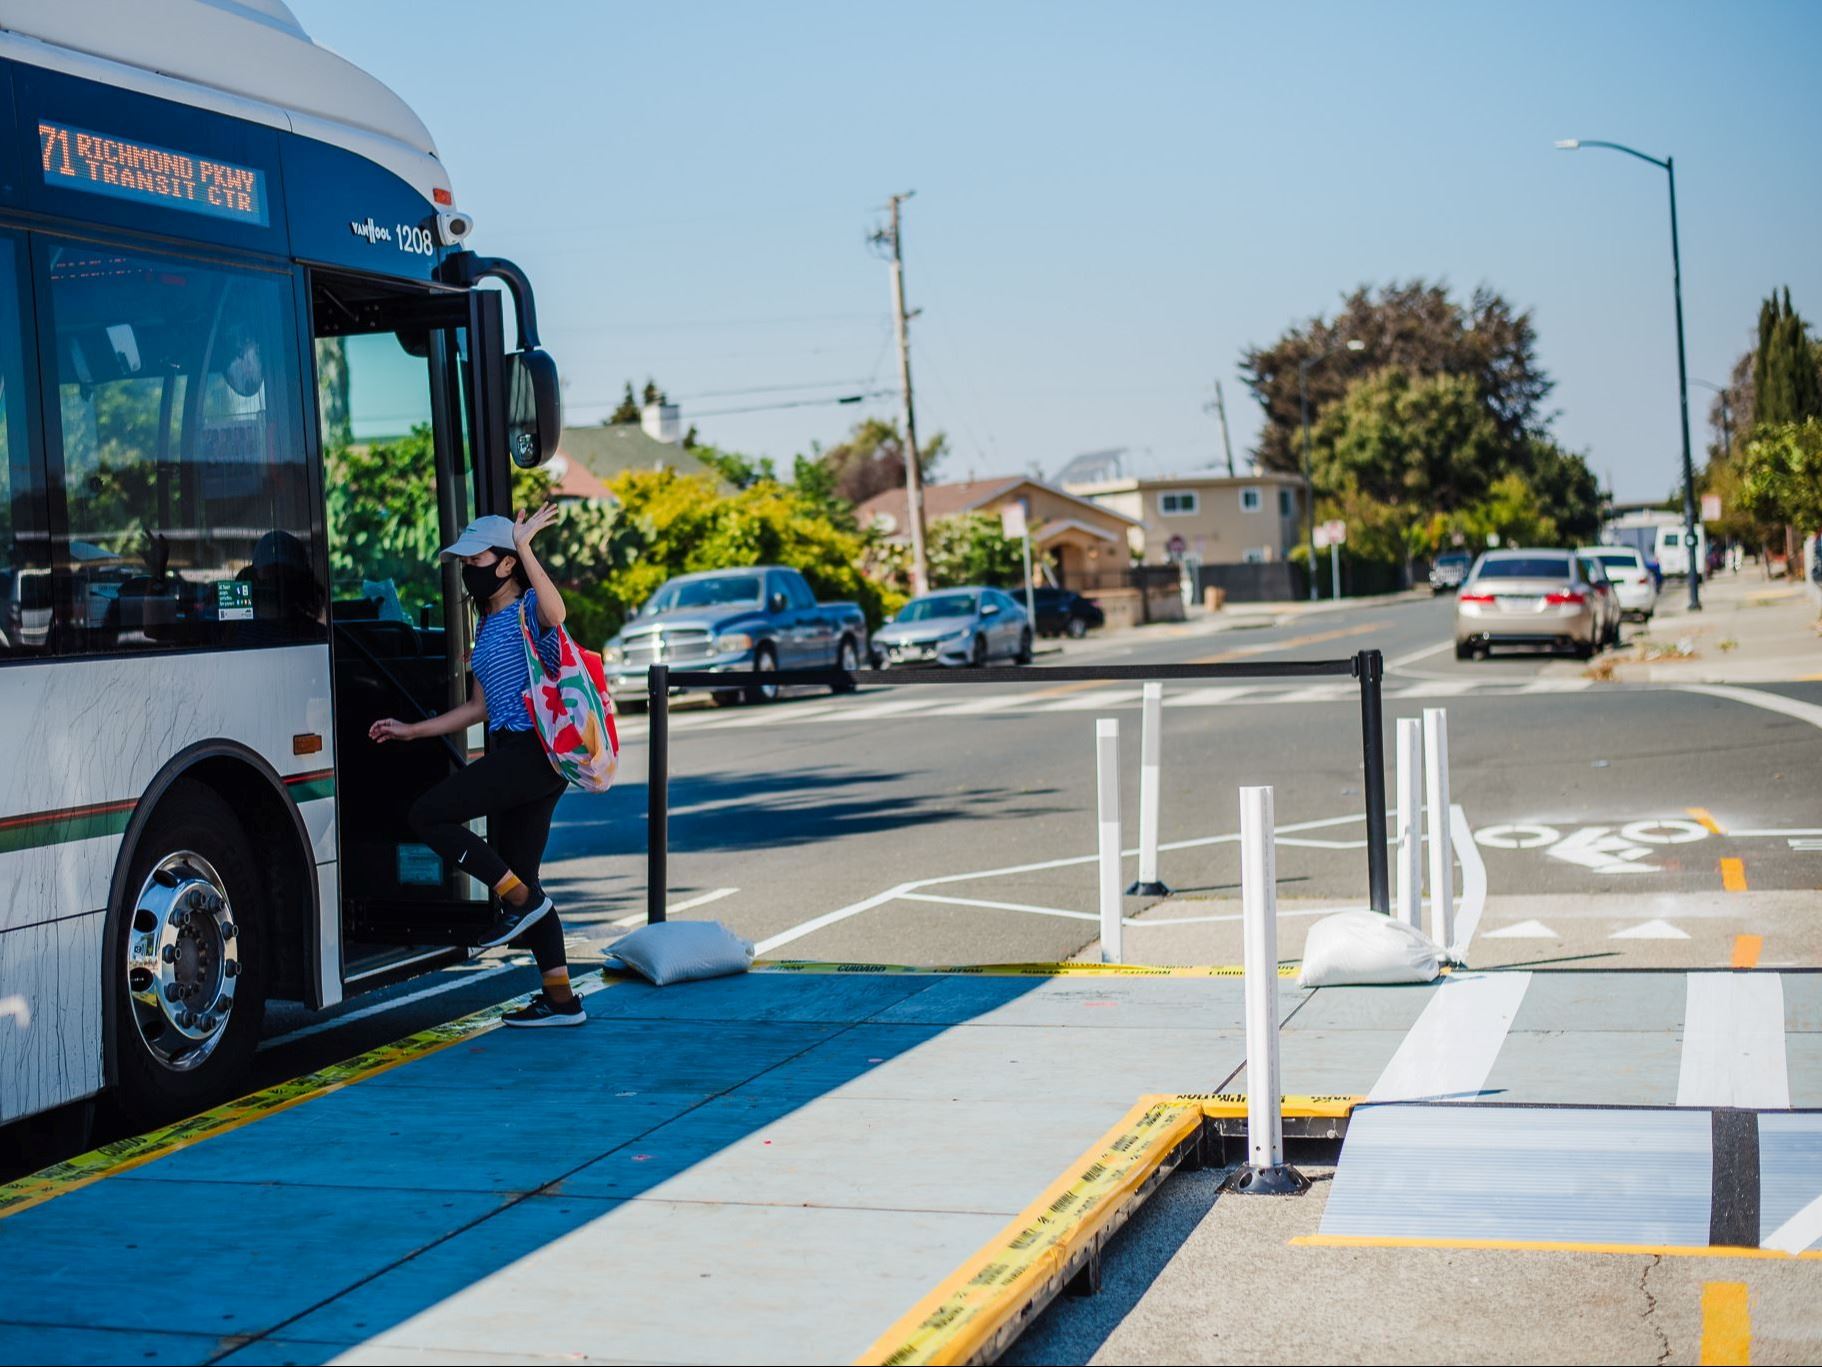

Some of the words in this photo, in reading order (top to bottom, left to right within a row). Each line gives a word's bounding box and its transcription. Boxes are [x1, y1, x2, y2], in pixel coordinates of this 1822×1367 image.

[39, 124, 75, 176] 71
[77, 133, 193, 179] RICHMOND
[200, 161, 254, 192] PKWY
[86, 160, 196, 200] TRANSIT
[208, 186, 252, 211] CTR
[396, 223, 433, 256] 1208
[837, 963, 887, 973] CUIDADO
